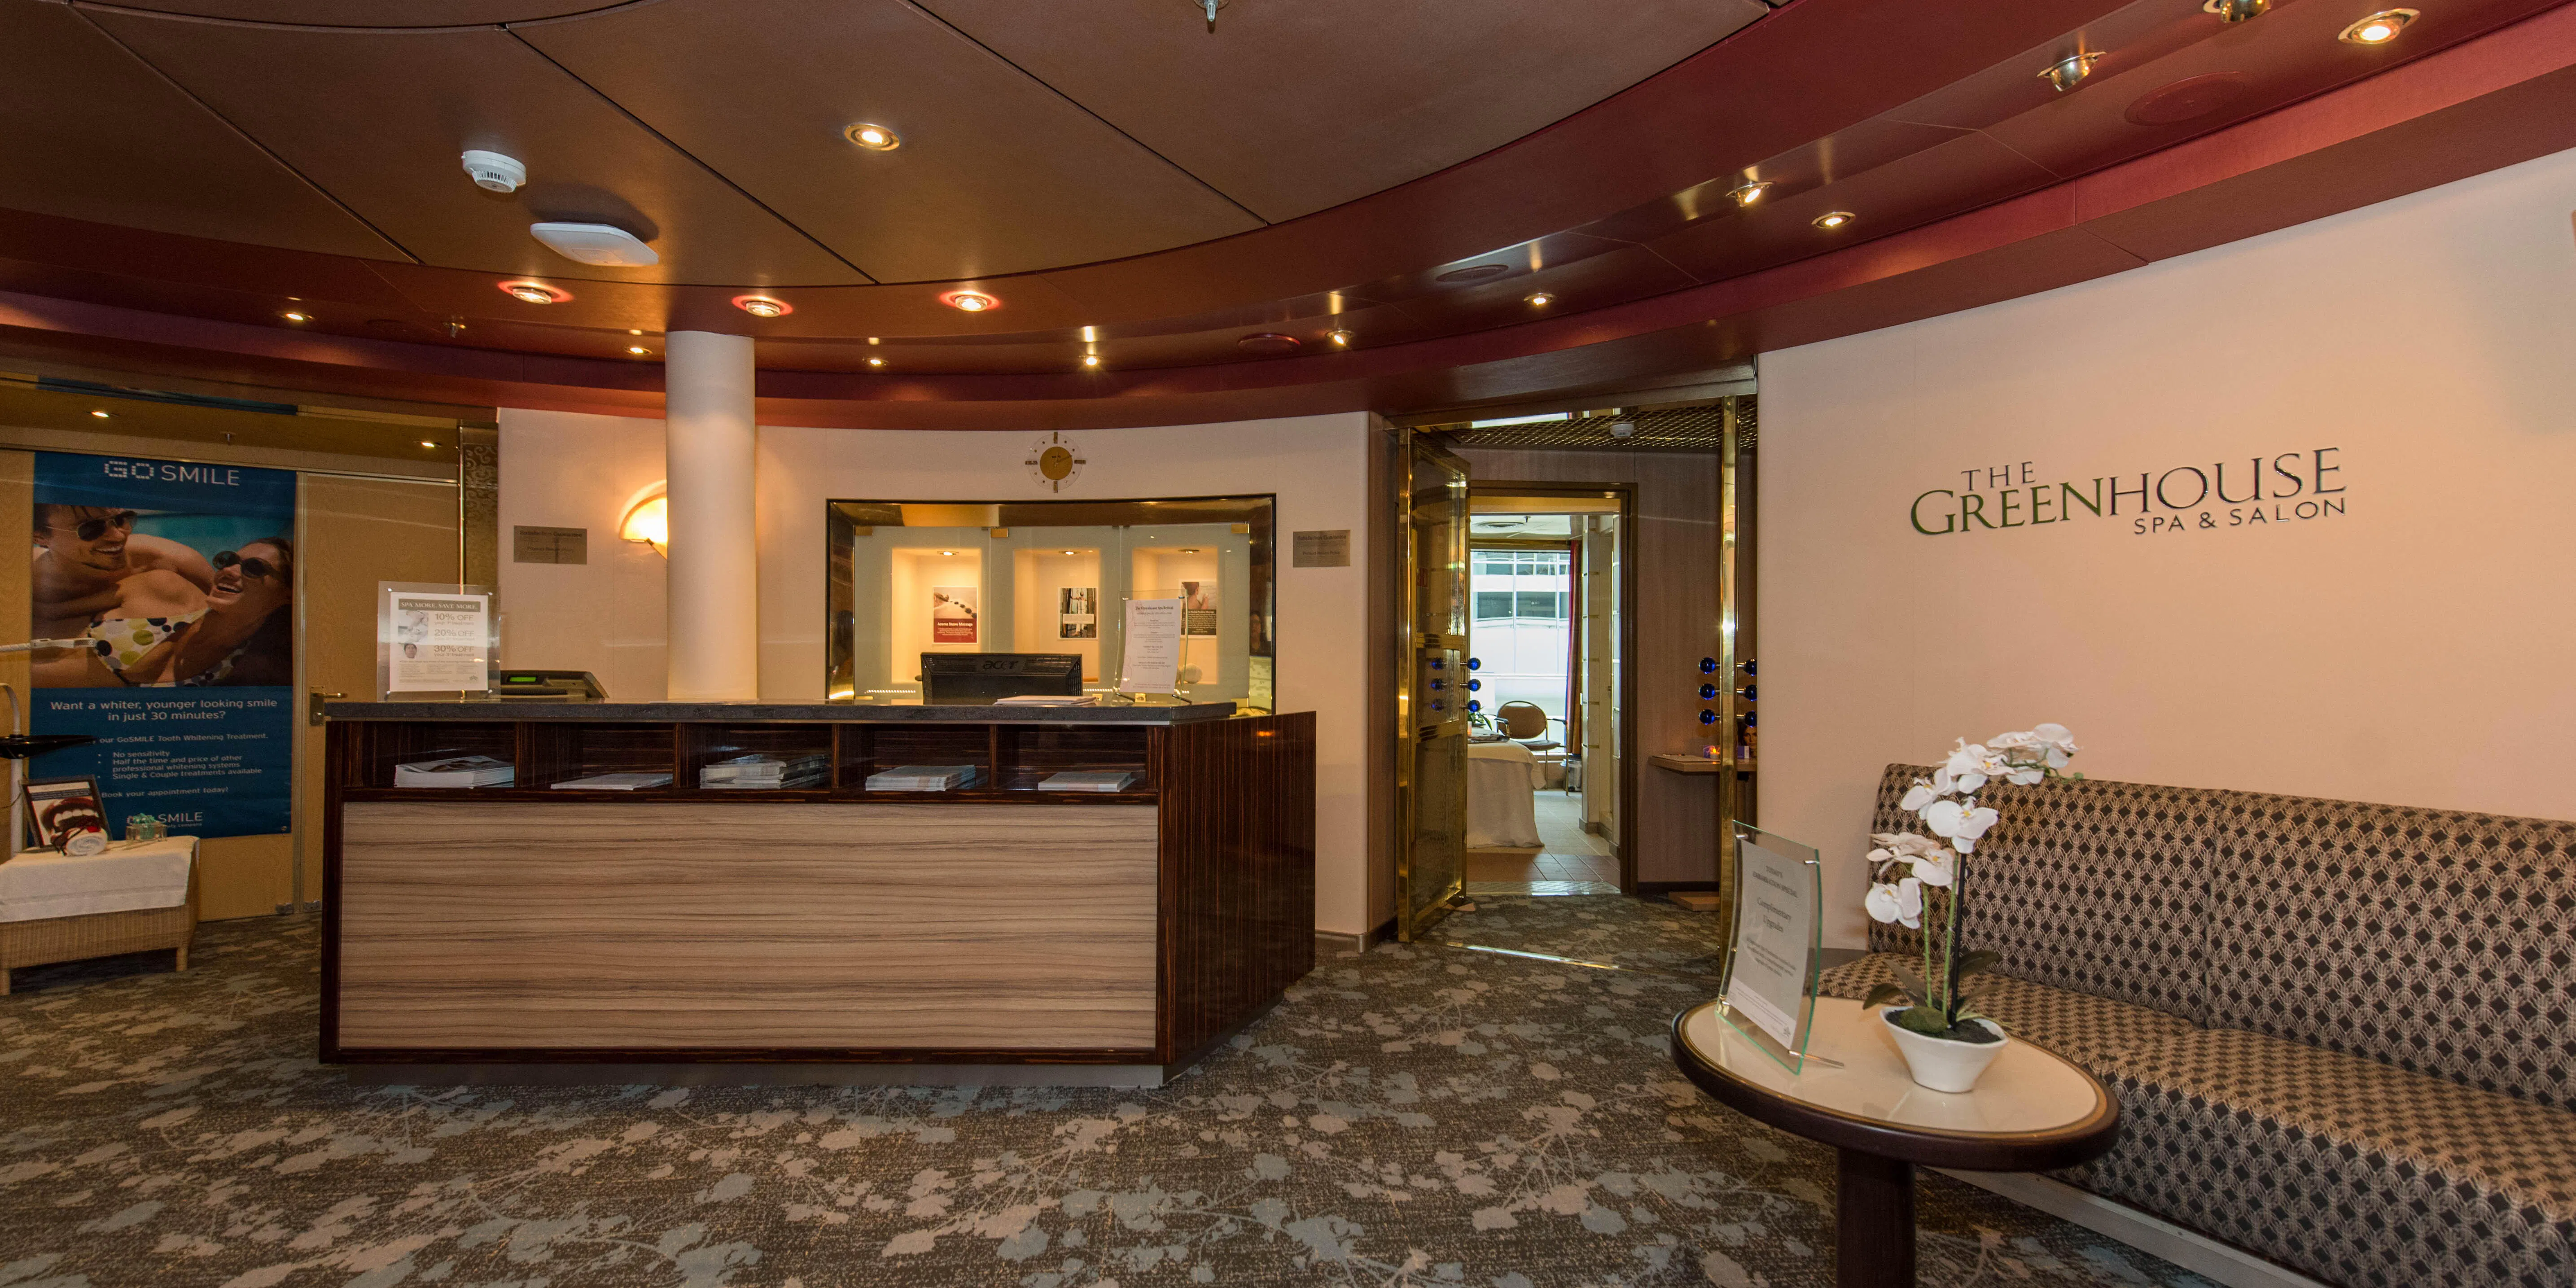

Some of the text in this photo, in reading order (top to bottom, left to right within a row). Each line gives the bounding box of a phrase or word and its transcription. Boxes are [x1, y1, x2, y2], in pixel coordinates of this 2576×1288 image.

[104, 460, 240, 486] GO SMILE
[1961, 461, 2036, 491] THE
[1910, 447, 2347, 535] GREENHOUSE
[2134, 497, 2345, 534] SPA & SALON
[983, 660, 1019, 670] acer
[50, 701, 83, 710] Want
[100, 701, 142, 710] whiter,
[146, 700, 196, 710] younger
[200, 699, 243, 709] looking
[247, 699, 277, 707] smile
[108, 710, 226, 722] in just 30 minutes?
[113, 765, 164, 773] professional
[158, 811, 203, 824] SMILE
